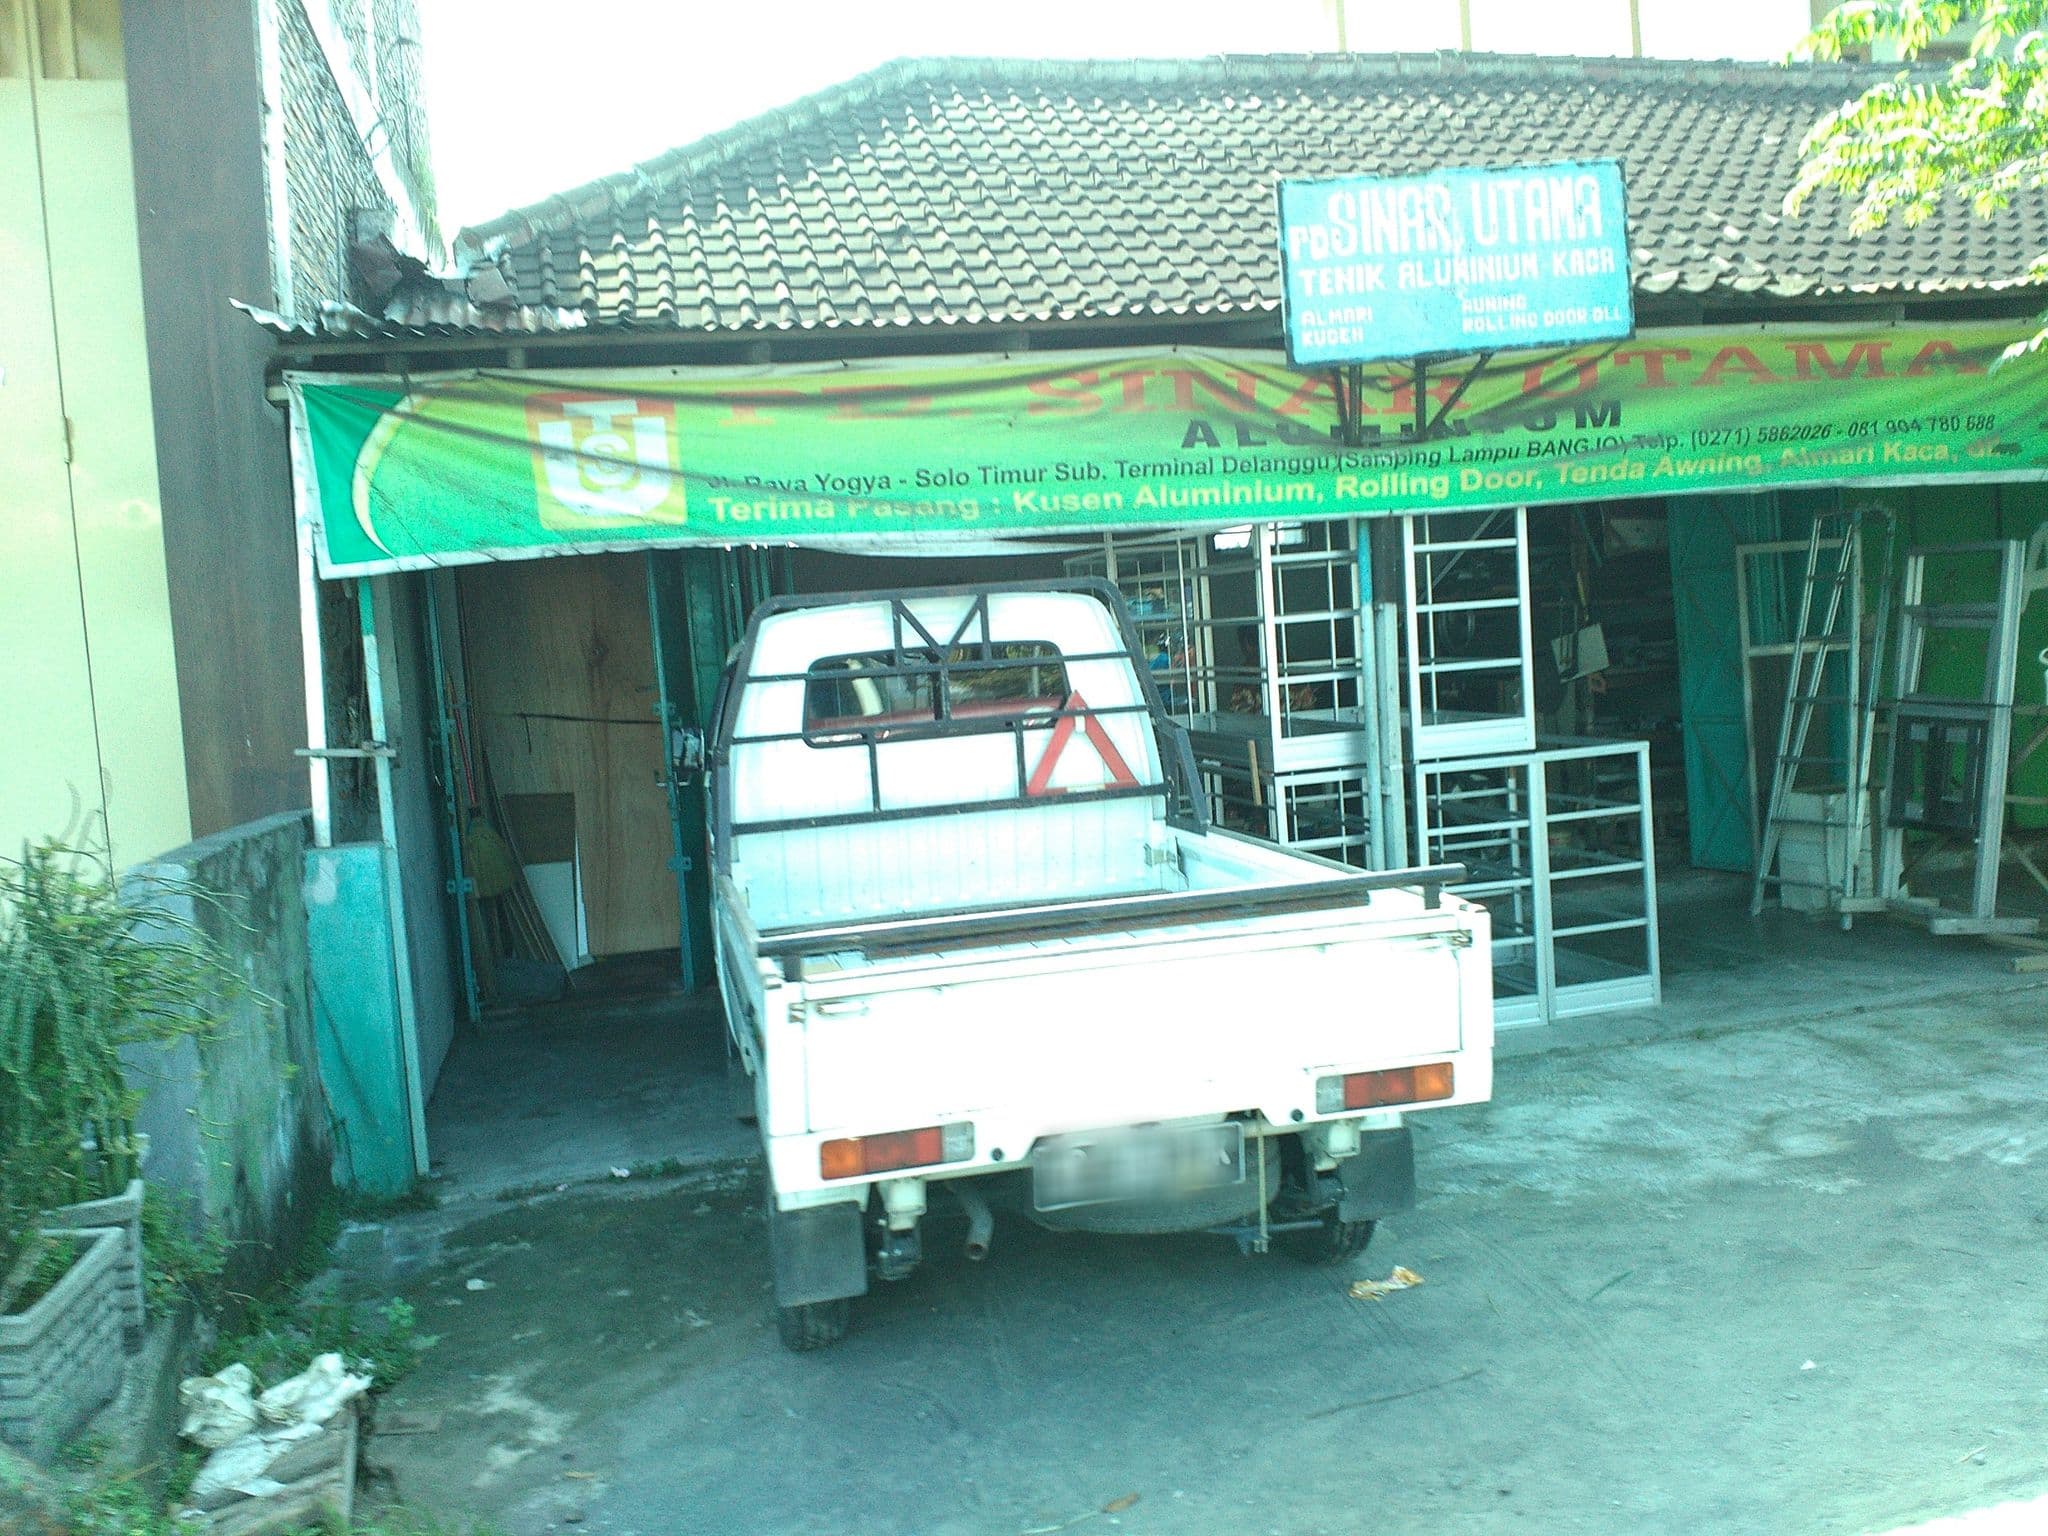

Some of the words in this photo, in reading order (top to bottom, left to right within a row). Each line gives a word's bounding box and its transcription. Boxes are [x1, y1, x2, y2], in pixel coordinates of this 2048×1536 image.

[1327, 183, 1455, 257] SINAR
[1471, 174, 1603, 246] UTAMA
[1299, 264, 1386, 298] TENIK
[1398, 253, 1540, 291] ALUMINIUM
[1553, 247, 1616, 278] KACA
[1301, 306, 1374, 327] ALMARI
[1462, 311, 1538, 334] ROLLING
[1543, 307, 1588, 328] DOOR
[1521, 339, 1990, 399] UTAMA
[707, 495, 835, 522] Terima
[1012, 489, 1123, 516] Kusen
[1132, 478, 1325, 510] Aluminium,
[1336, 470, 1450, 501] Rolling
[1460, 466, 1544, 494] Door,
[1555, 457, 1646, 486] Tenda
[1883, 440, 1959, 464] Kaca,
[814, 472, 891, 496] Yogya
[915, 468, 971, 488] Solo
[978, 465, 1048, 486] Timur
[1054, 461, 1107, 482] Sub.
[1114, 455, 1214, 479] Terminal
[1449, 443, 1520, 465] Lampu
[1691, 426, 1751, 450] (0271)
[1757, 422, 1832, 443] 5862026
